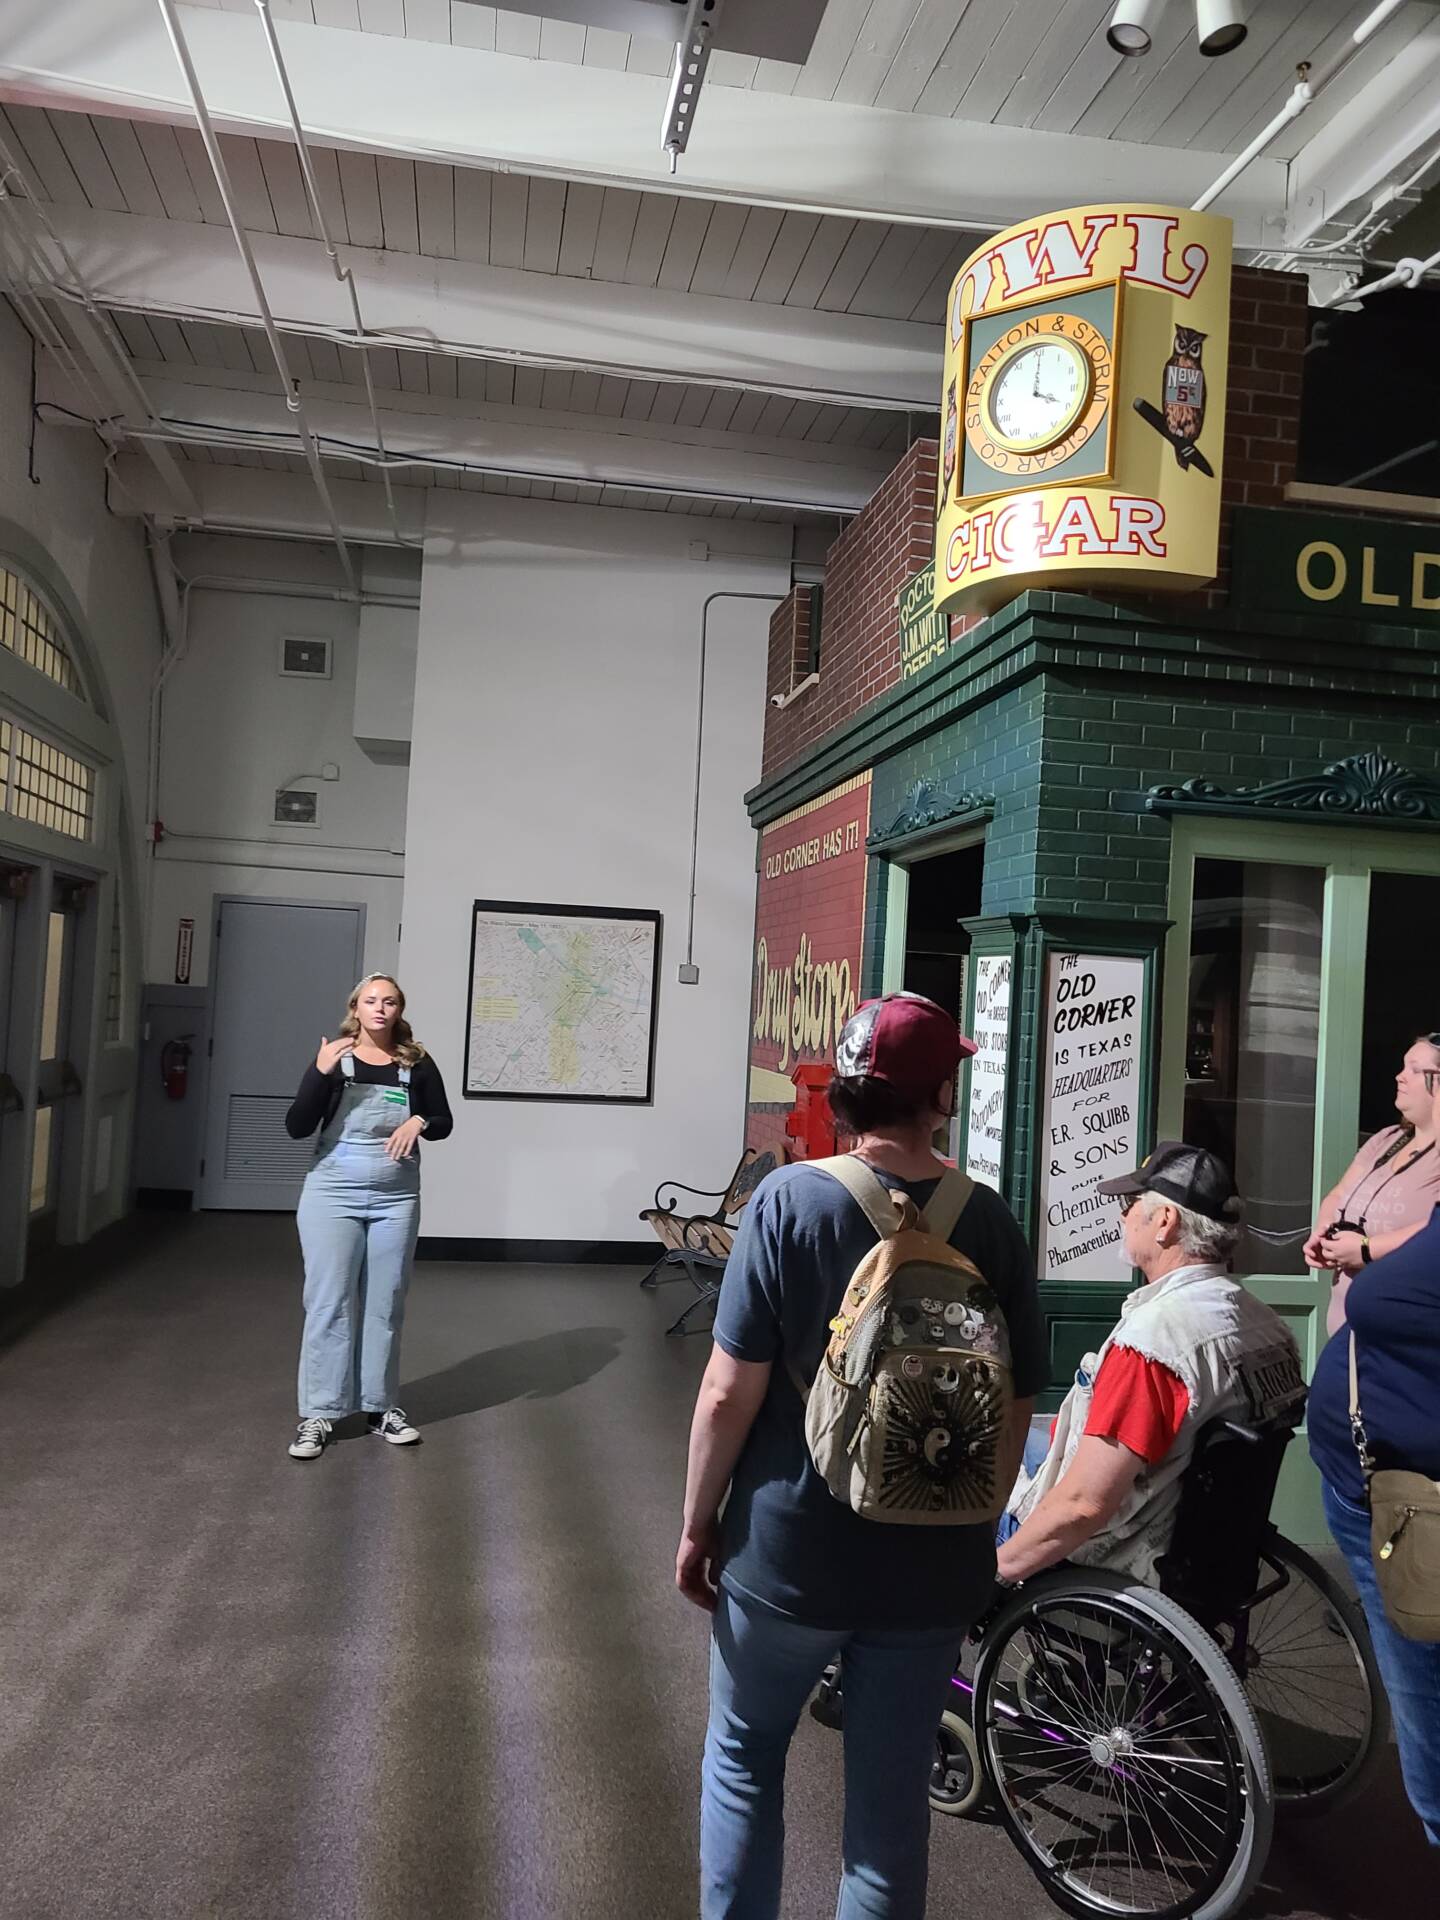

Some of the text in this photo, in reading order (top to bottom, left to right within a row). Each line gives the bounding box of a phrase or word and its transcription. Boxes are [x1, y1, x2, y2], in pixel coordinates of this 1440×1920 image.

[952, 214, 1209, 349] OWL
[1052, 315, 1064, 332] &
[967, 319, 1040, 428] STRAITON
[1073, 322, 1110, 402] STORM
[1168, 366, 1199, 388] NOW
[1018, 425, 1088, 472] CIGAR
[946, 496, 1167, 582] CIGAR
[1296, 541, 1440, 610] OLD
[901, 571, 935, 629] DOCTO
[766, 820, 859, 879] OLD CORNER HAS IT!
[1060, 953, 1080, 971] THE
[754, 932, 855, 1072] Drug Store
[977, 990, 988, 1014] OLD
[1057, 973, 1096, 1003] OLD
[1054, 995, 1136, 1034] CORNER
[975, 1030, 988, 1049] DRUG
[1055, 1033, 1132, 1066] IS TEXAS
[983, 1060, 1006, 1076] TEXAS
[1051, 1057, 1133, 1099] HEADQUARTERS
[1072, 1092, 1111, 1112] FOR
[1082, 1104, 1130, 1134] SQUIBB
[1050, 1136, 1129, 1176] & SONS
[1072, 1174, 1104, 1191] PURE
[1048, 1189, 1120, 1227] Chemica
[1069, 1217, 1106, 1237] AND
